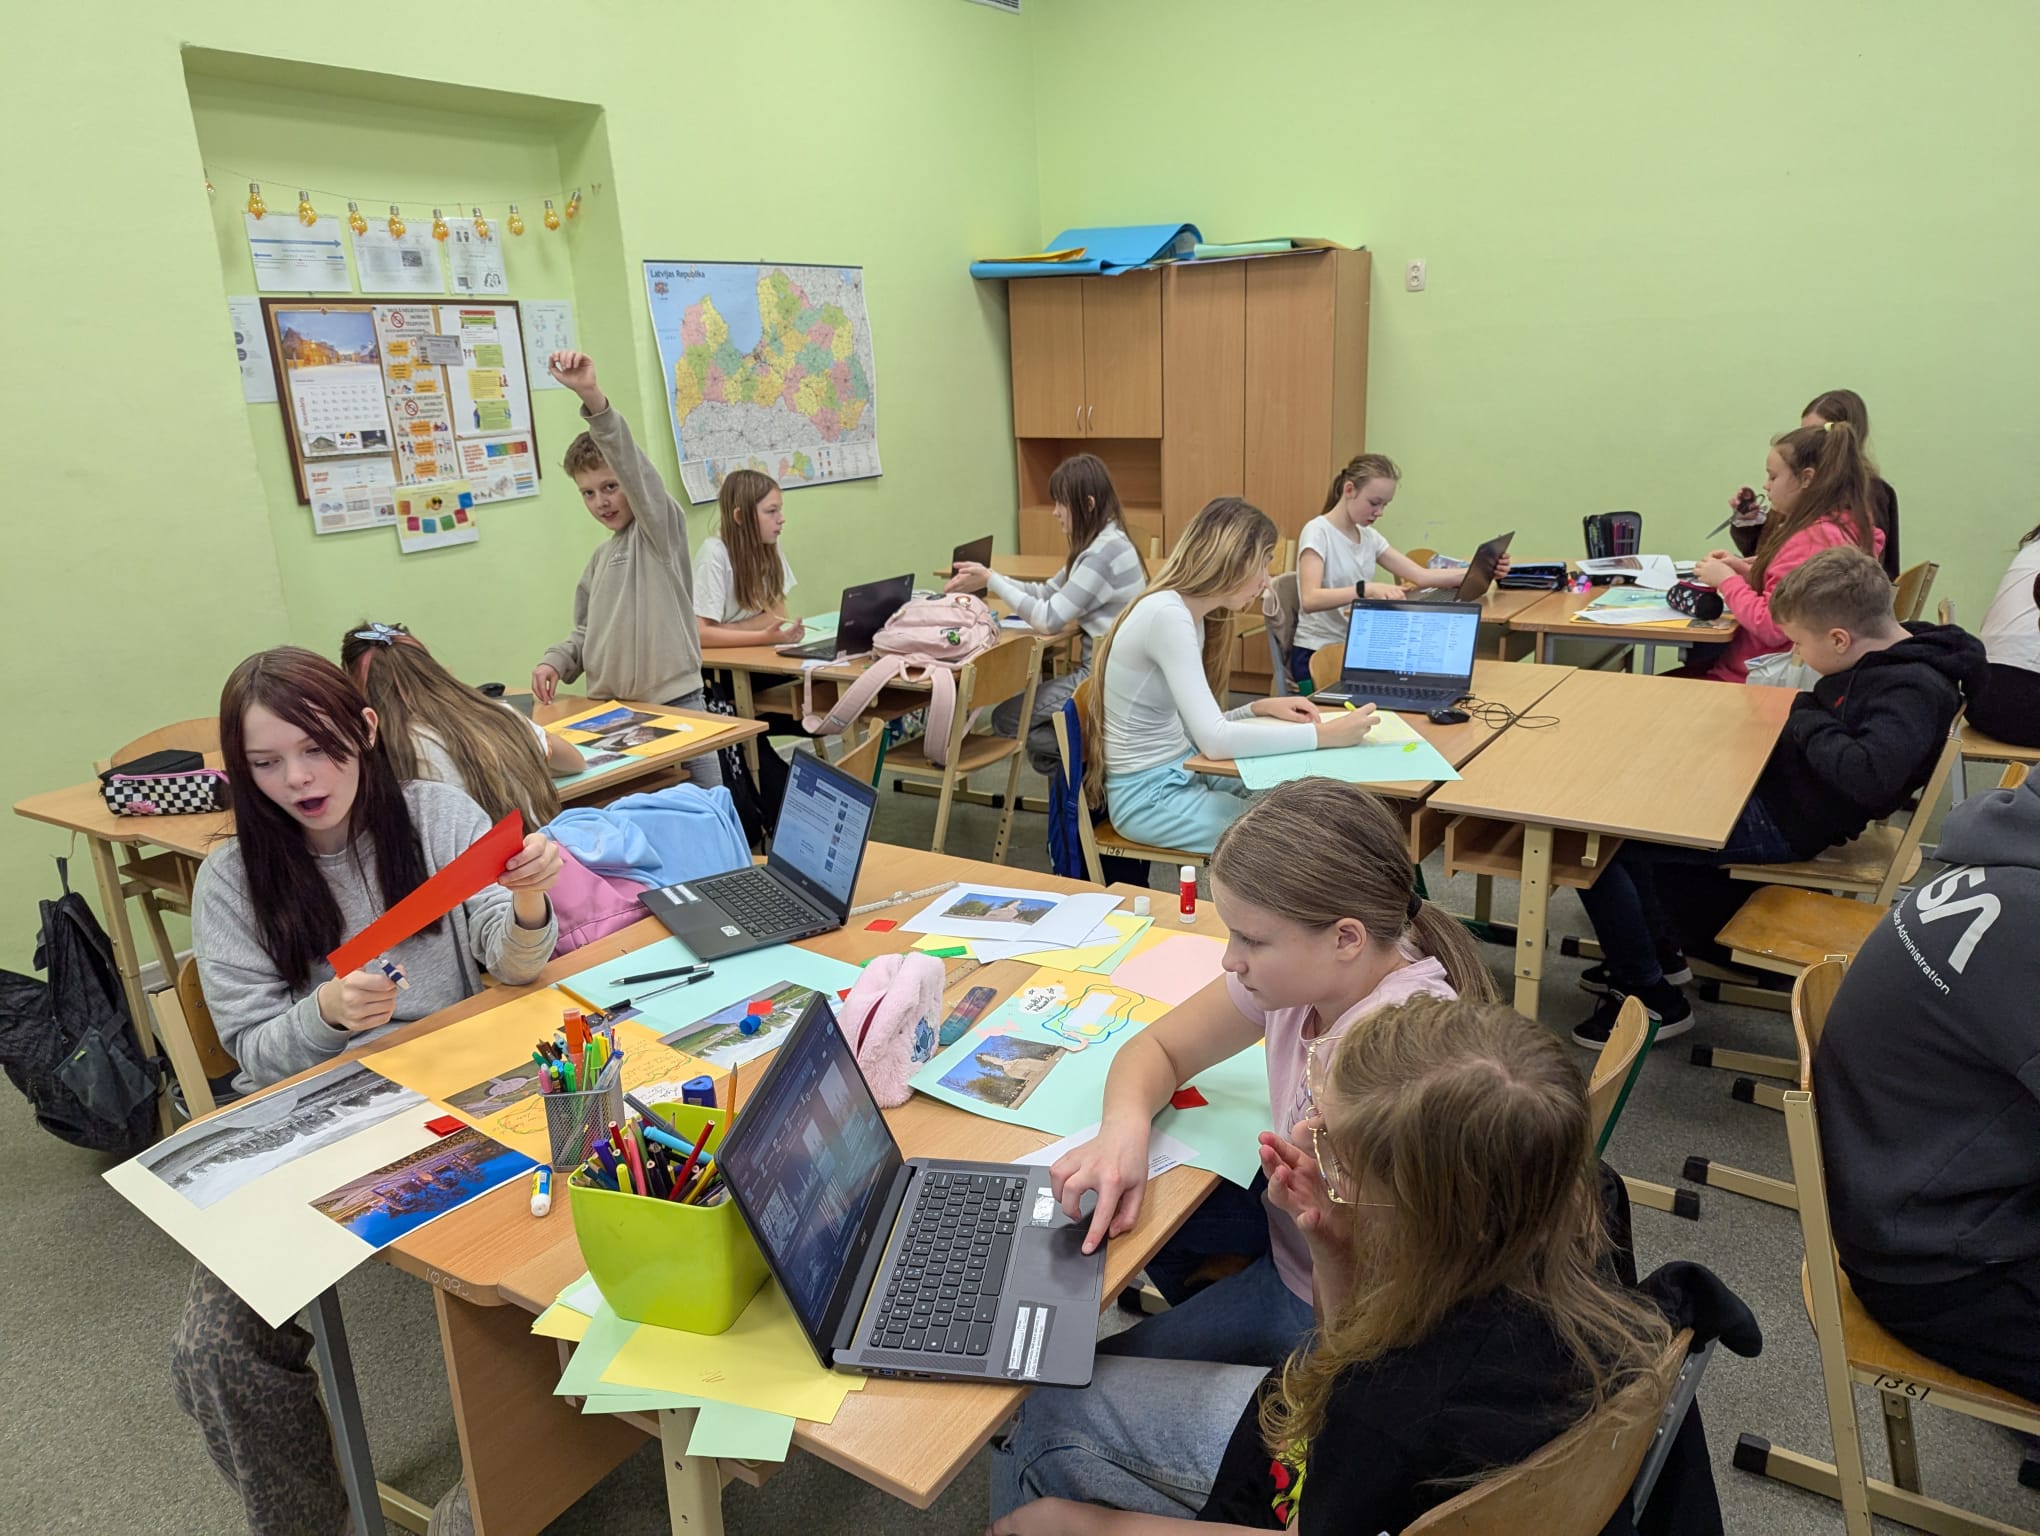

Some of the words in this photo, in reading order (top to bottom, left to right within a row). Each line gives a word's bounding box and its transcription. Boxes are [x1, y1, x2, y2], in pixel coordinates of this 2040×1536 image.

[650, 268, 675, 280] Latvijas
[675, 268, 705, 280] Republika
[1896, 923, 1951, 995] Administration
[1873, 1373, 1931, 1401] 1361
